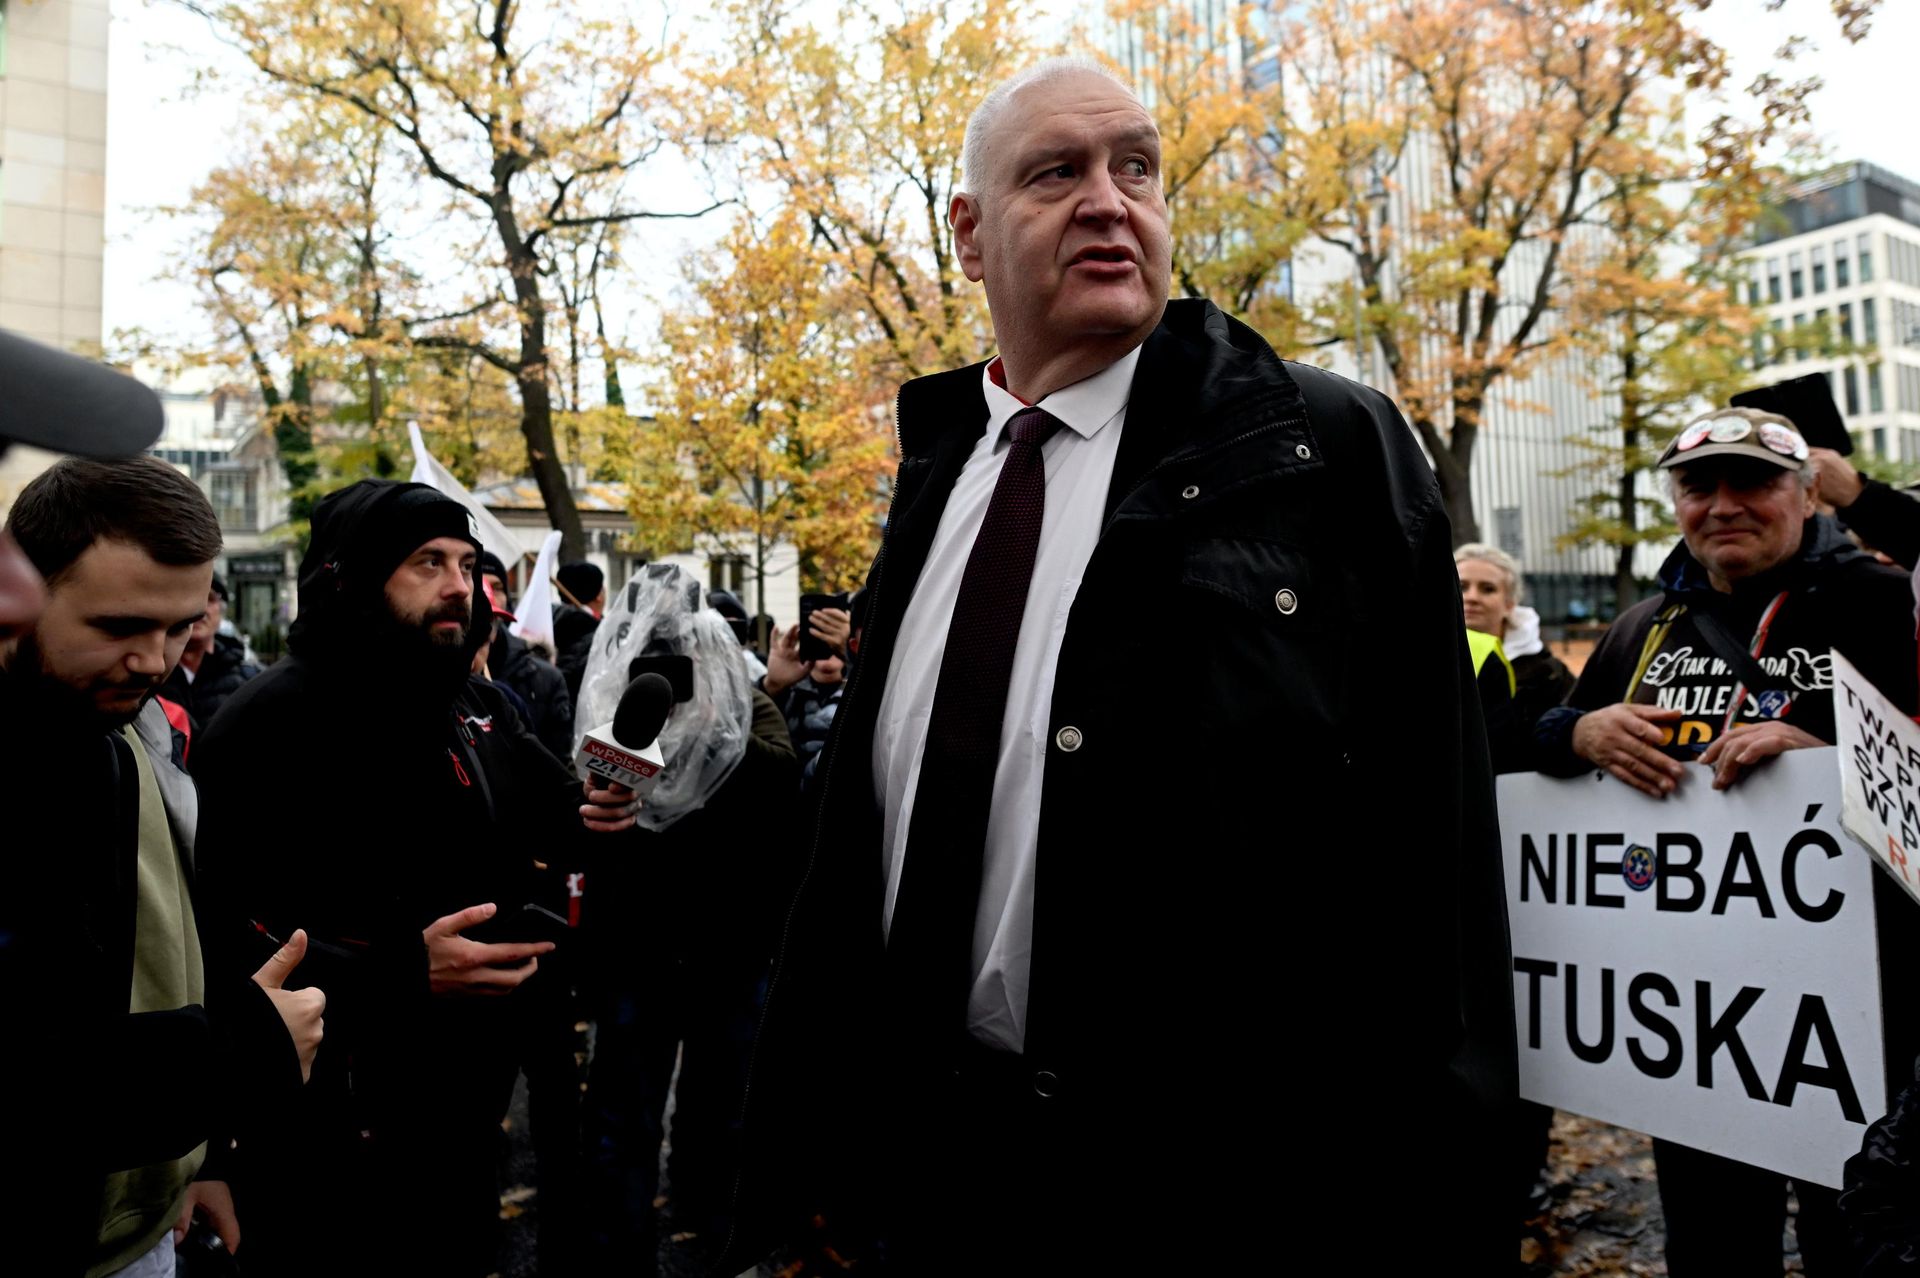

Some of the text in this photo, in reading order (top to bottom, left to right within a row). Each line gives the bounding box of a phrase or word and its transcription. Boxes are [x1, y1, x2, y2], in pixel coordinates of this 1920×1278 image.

[1680, 656, 1711, 676] TAK
[591, 744, 651, 776] wPolsce
[1520, 803, 1846, 923] NIE BAĆ
[1513, 956, 1868, 1126] TUSKA
